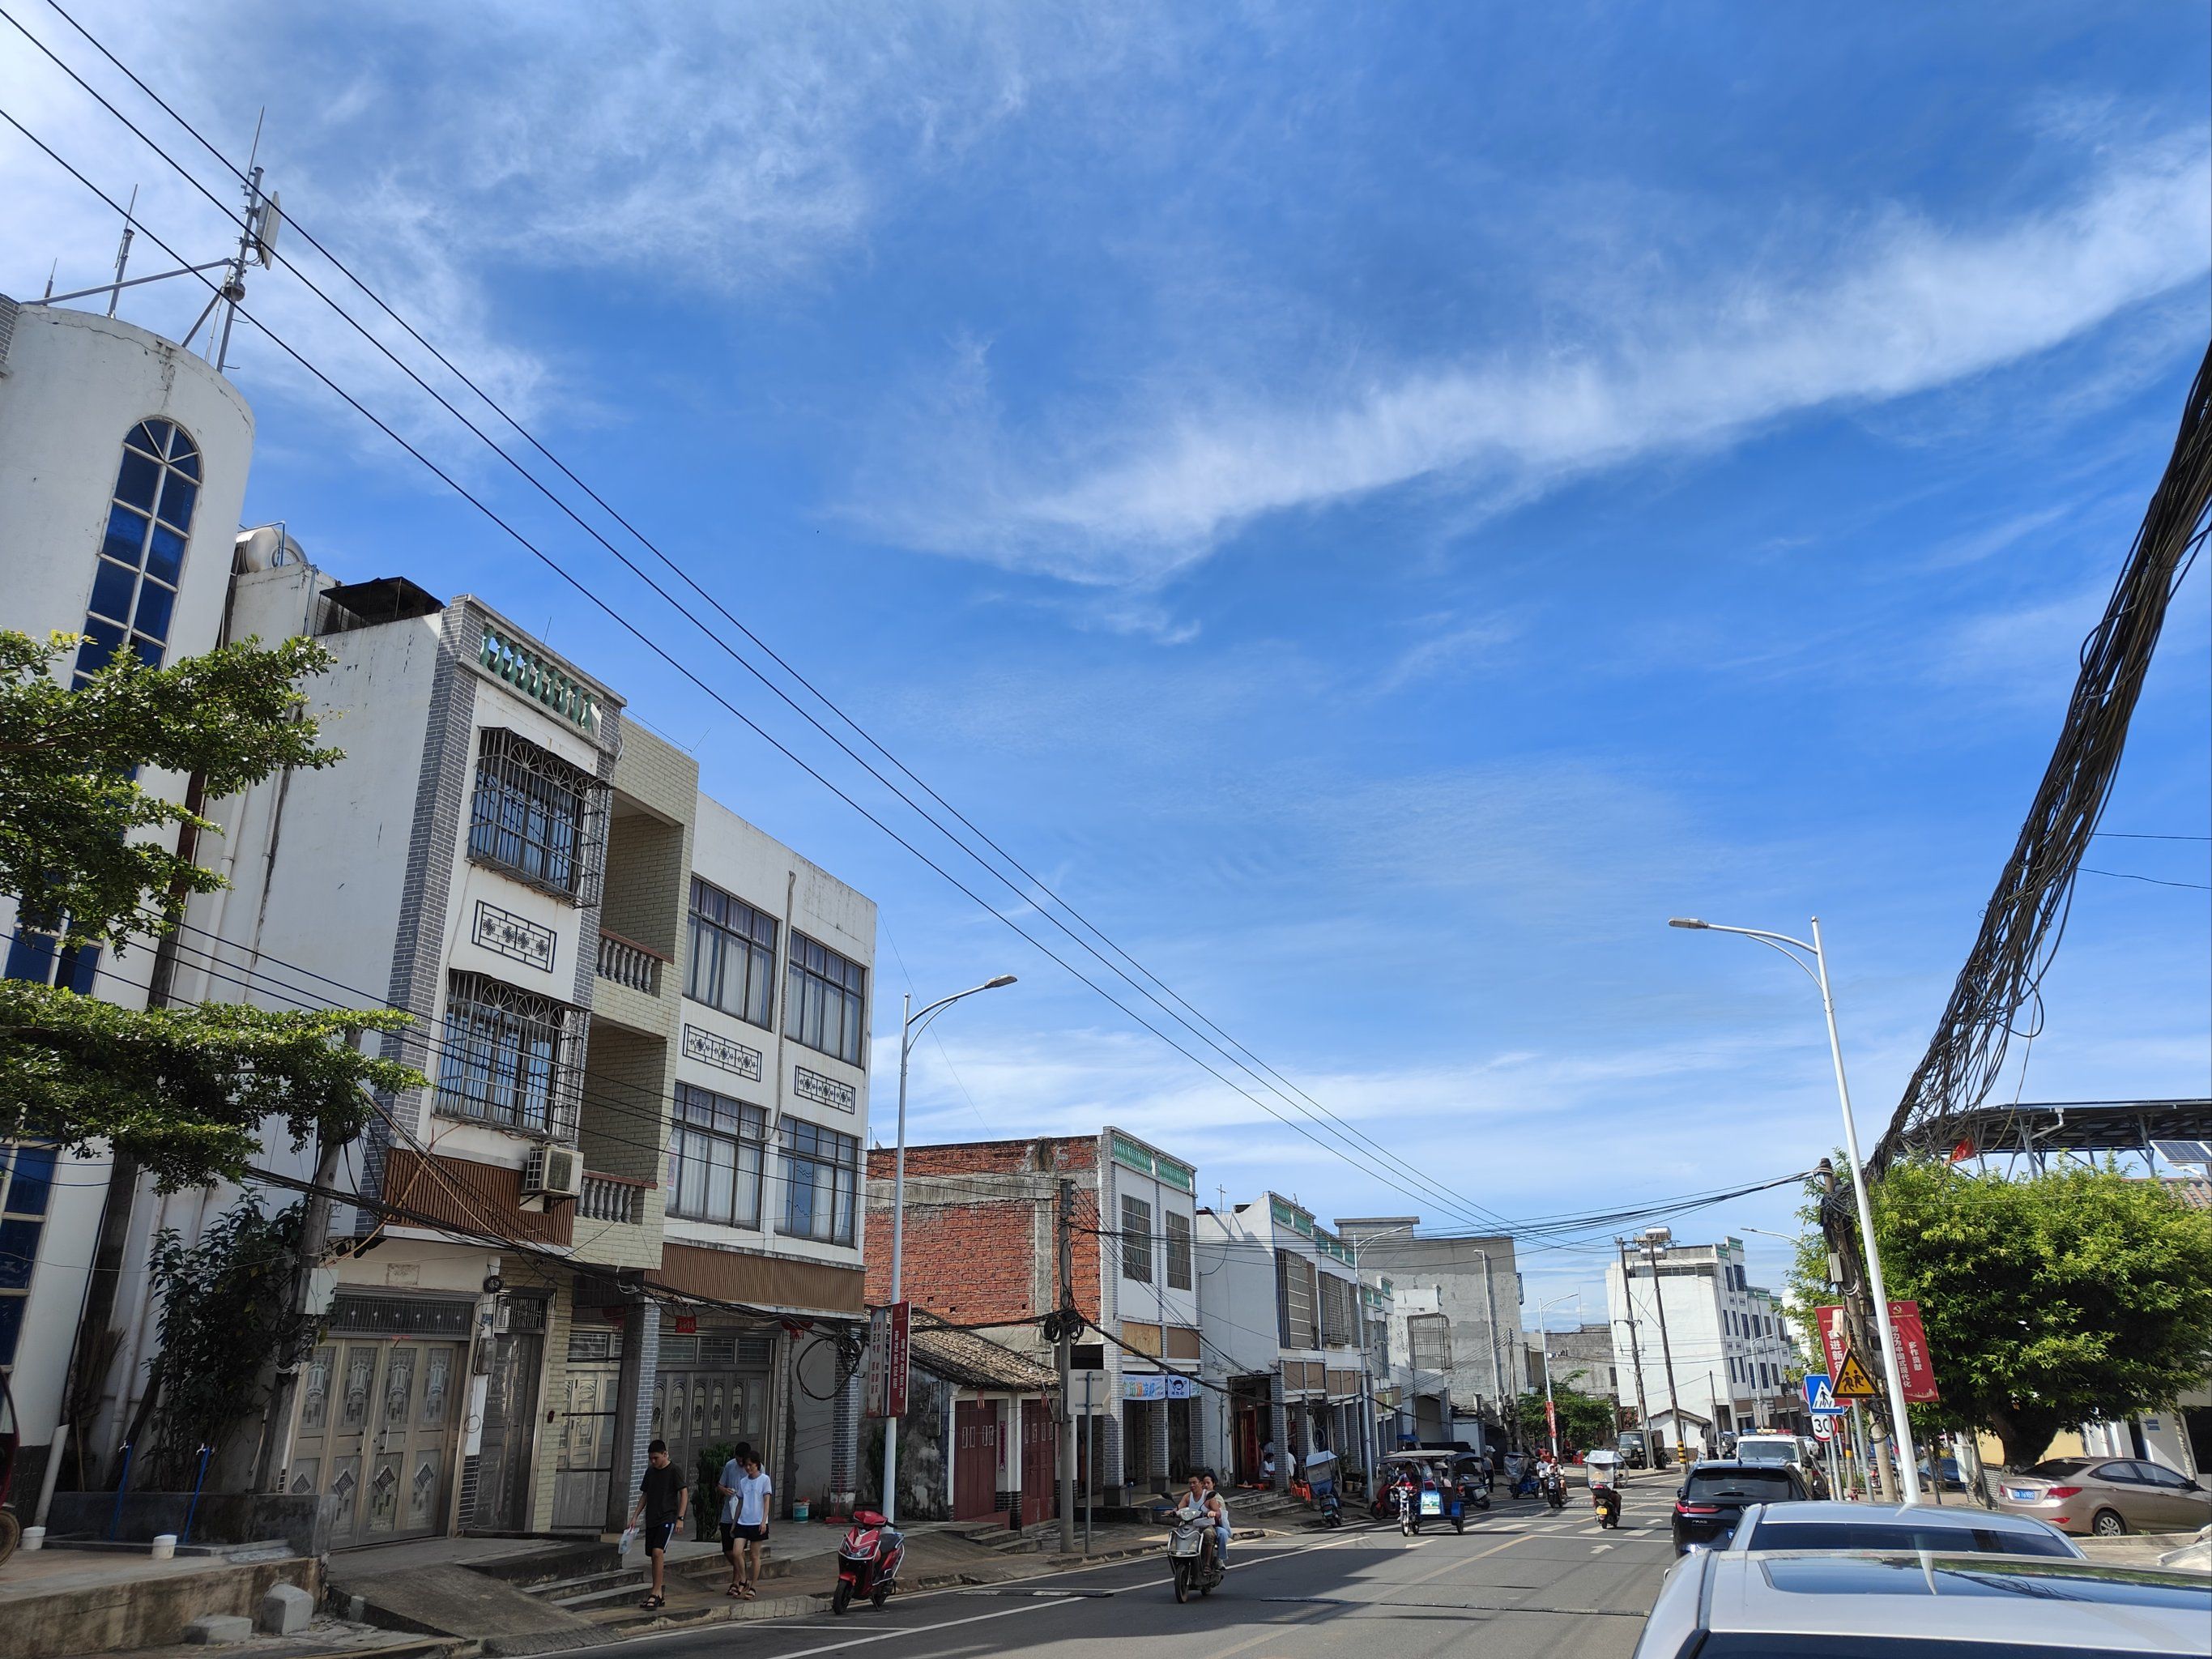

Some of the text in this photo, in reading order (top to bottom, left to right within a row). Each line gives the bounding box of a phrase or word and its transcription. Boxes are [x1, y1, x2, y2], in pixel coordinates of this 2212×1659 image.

[1890, 1325, 1912, 1388] 努力为中国式现代化
[1908, 1341, 1923, 1371] 多作贡献
